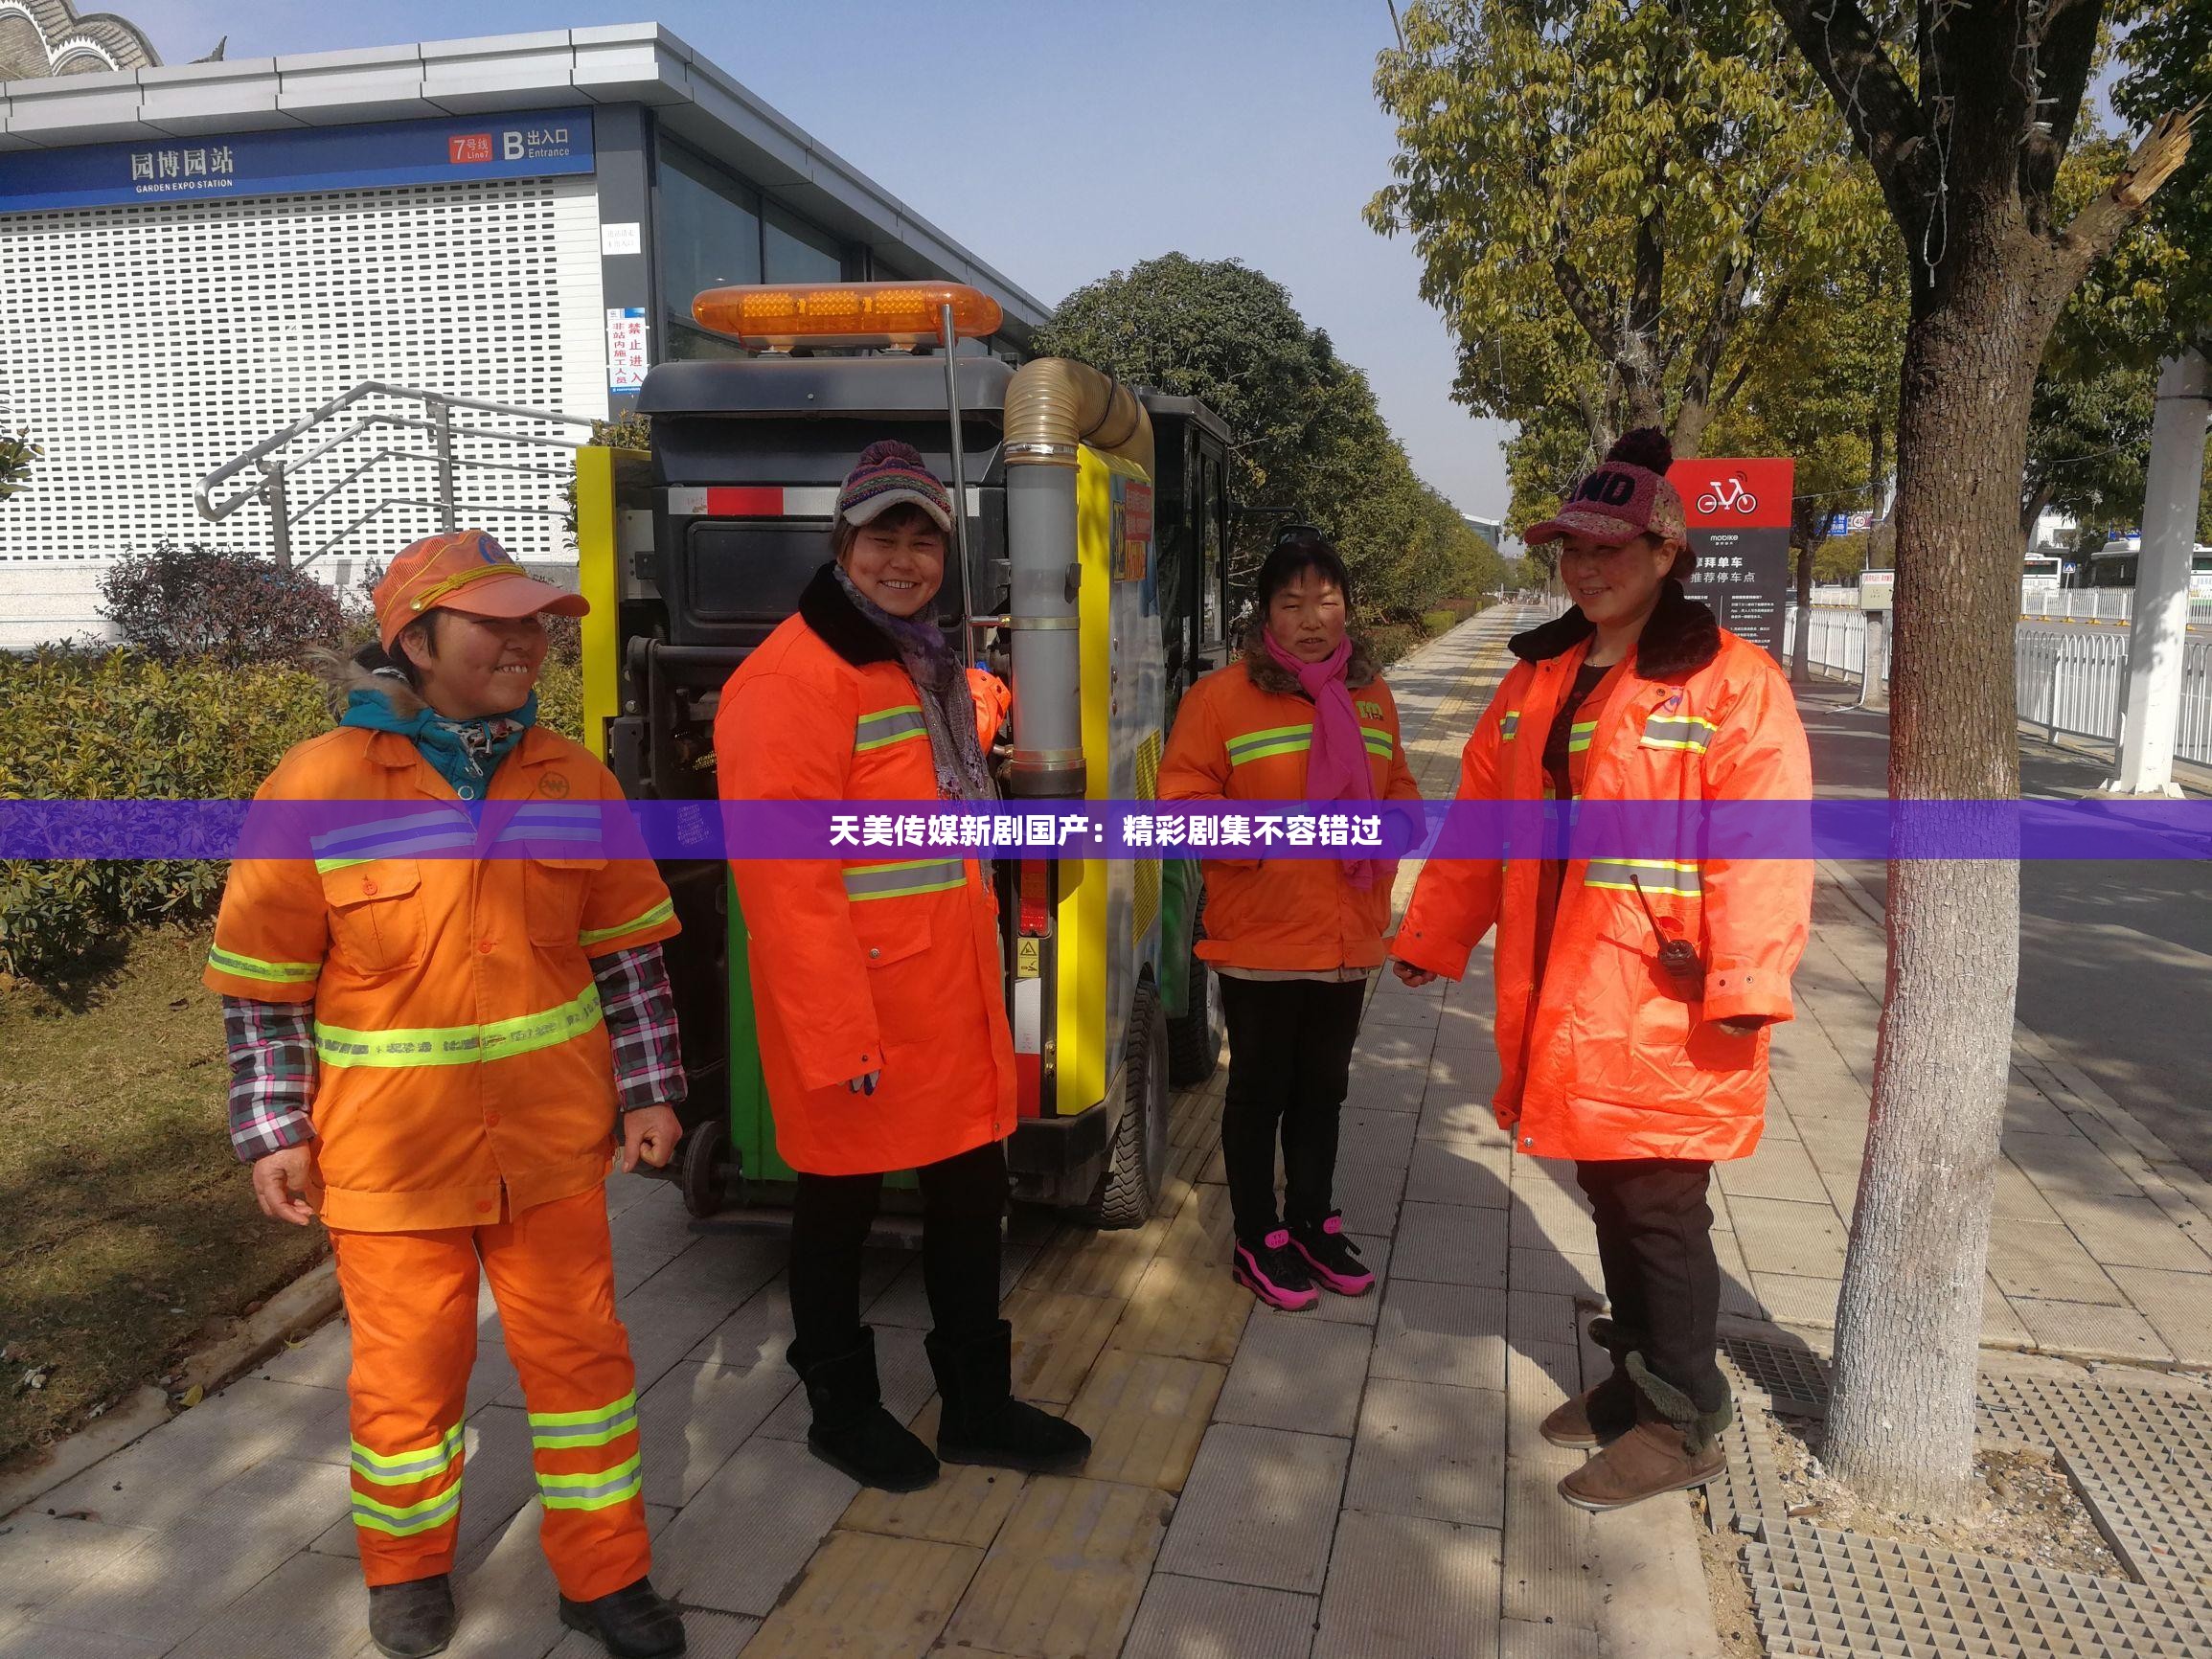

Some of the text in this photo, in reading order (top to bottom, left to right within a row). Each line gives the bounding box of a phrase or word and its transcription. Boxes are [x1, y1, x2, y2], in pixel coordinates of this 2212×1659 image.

[503, 131, 525, 160] B
[527, 128, 568, 146] 出入口
[131, 146, 234, 181] 园博园站
[529, 148, 570, 158] Entrance
[136, 179, 233, 193] GARDEN EXPO STATION
[613, 322, 627, 384] 非站内施工人员
[628, 322, 644, 383] 禁止进入
[1690, 572, 1756, 583] 推荐停车点
